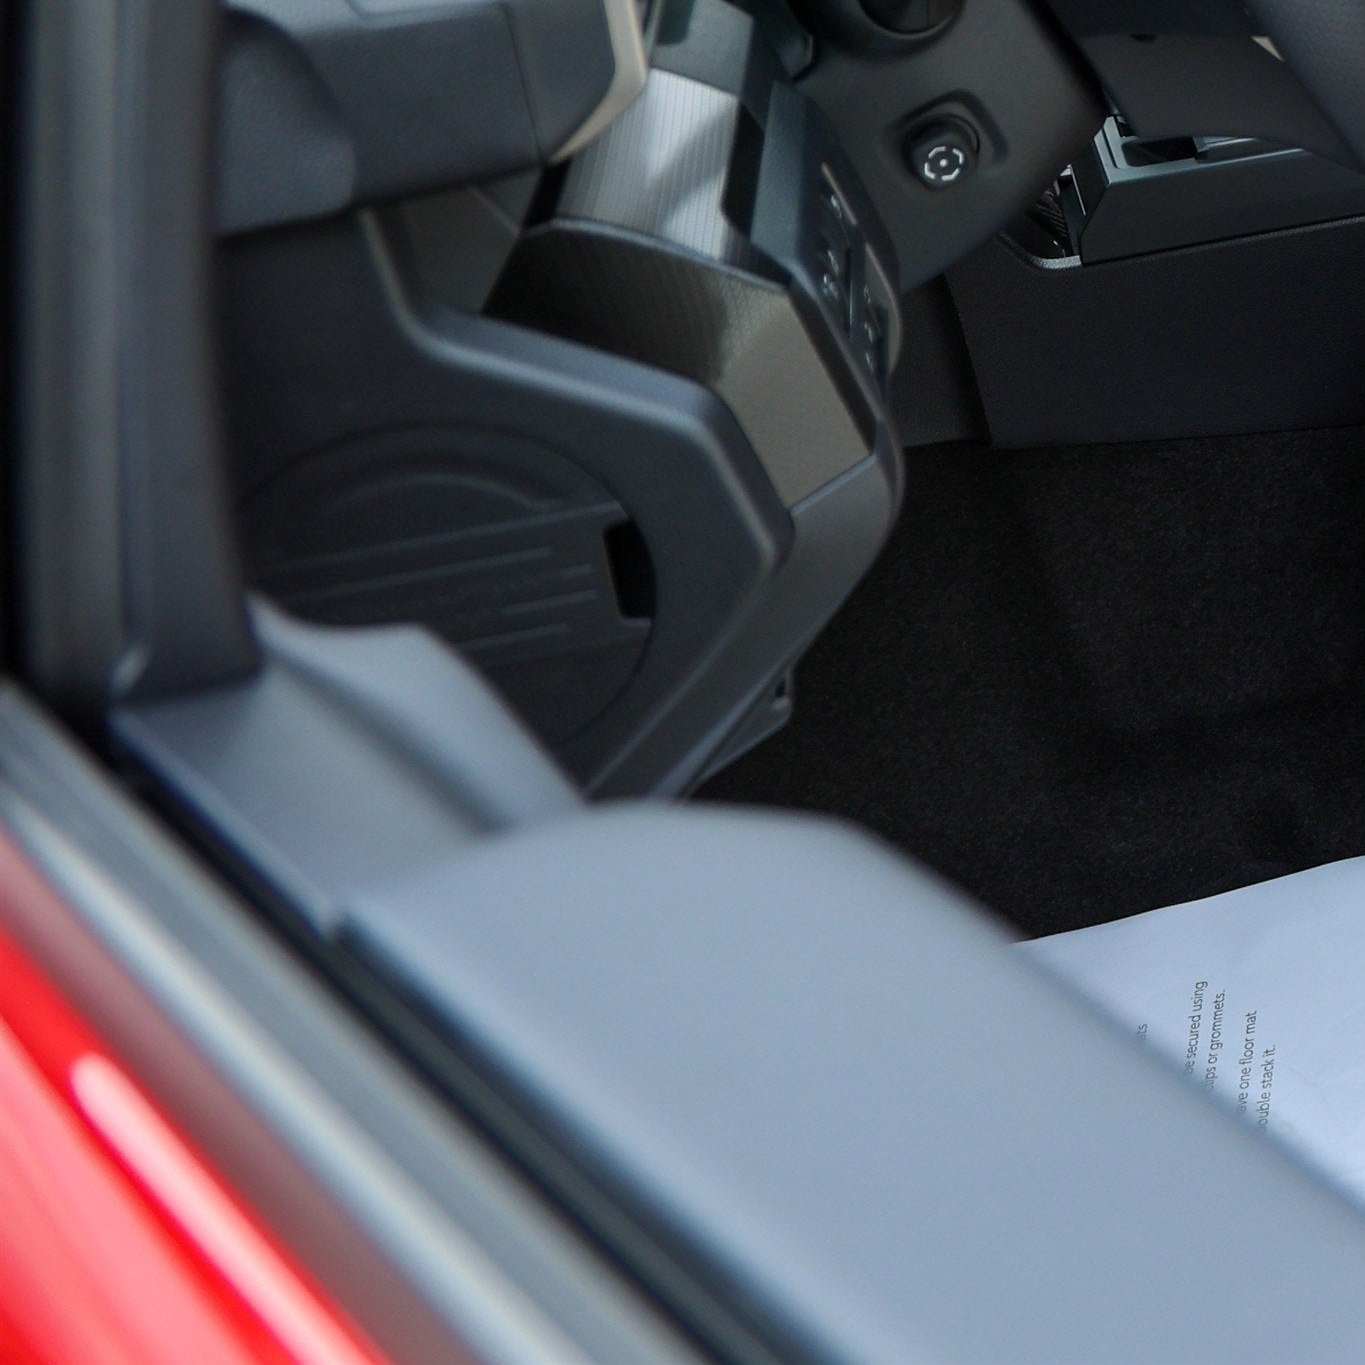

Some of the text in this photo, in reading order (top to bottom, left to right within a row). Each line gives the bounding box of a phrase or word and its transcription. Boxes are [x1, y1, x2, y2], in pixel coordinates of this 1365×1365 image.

[1192, 981, 1208, 1012] using
[1210, 989, 1226, 1052] grommets.
[1244, 1010, 1258, 1035] mat
[1187, 1014, 1202, 1059] secured
[1208, 1053, 1218, 1065] or
[1239, 1037, 1255, 1066] floor
[1262, 1044, 1276, 1059] it.
[1239, 1067, 1251, 1090] one
[1260, 1060, 1275, 1089] stack
